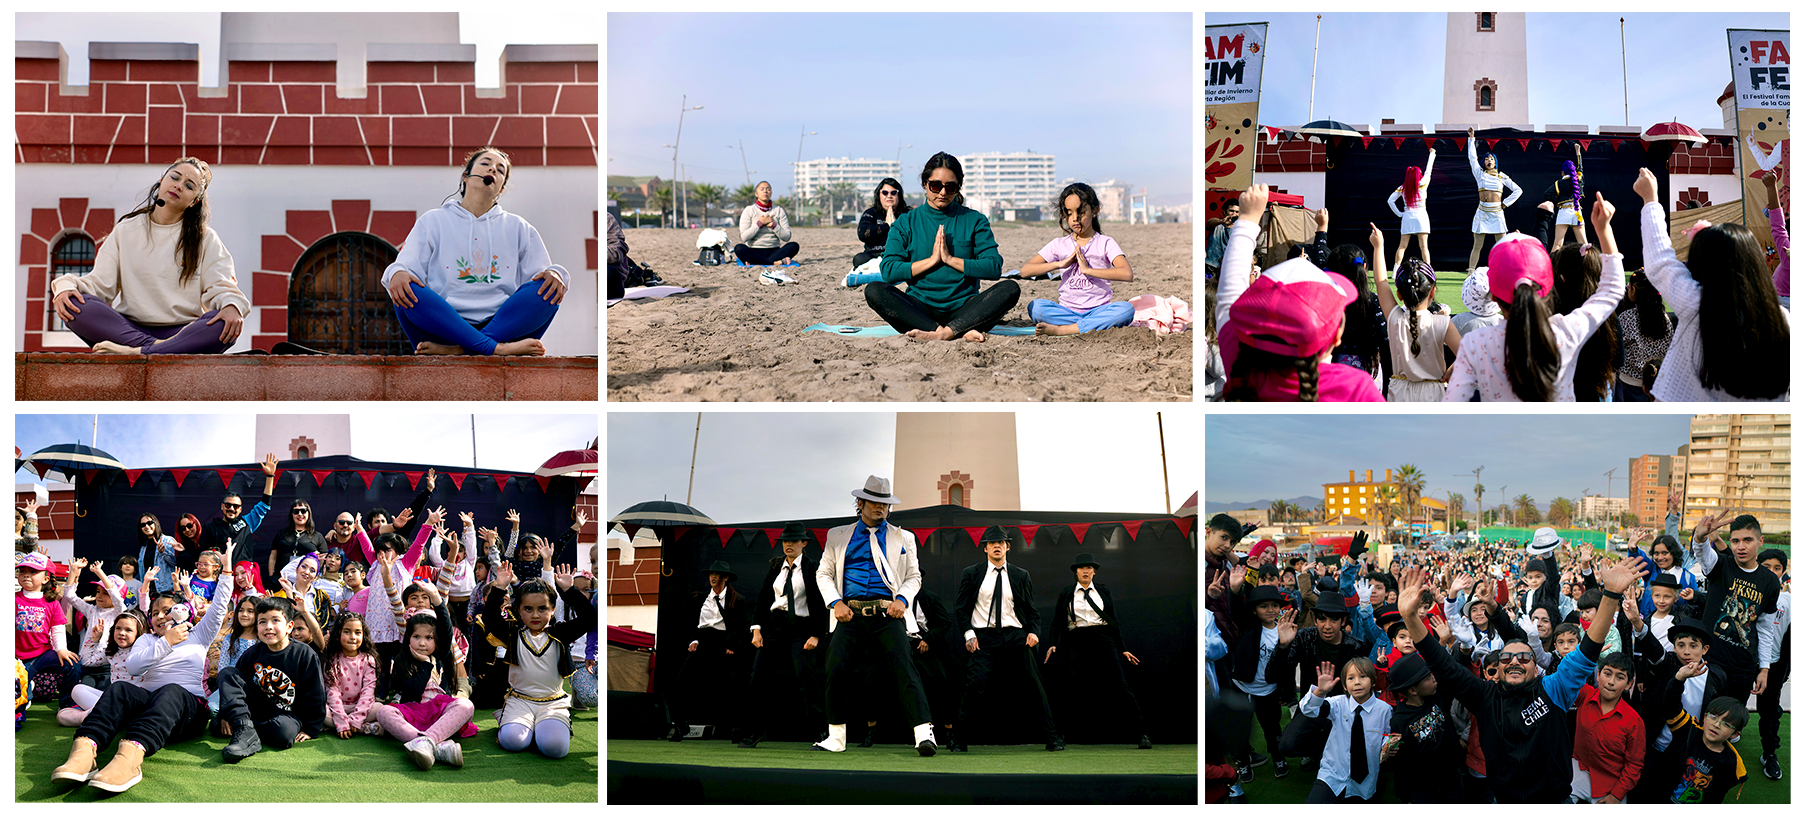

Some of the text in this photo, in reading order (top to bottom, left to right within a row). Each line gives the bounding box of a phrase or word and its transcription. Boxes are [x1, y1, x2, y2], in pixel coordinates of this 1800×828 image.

[1750, 40, 1790, 65] FA
[1214, 95, 1236, 103] Región
[1524, 704, 1550, 726] CHILE
